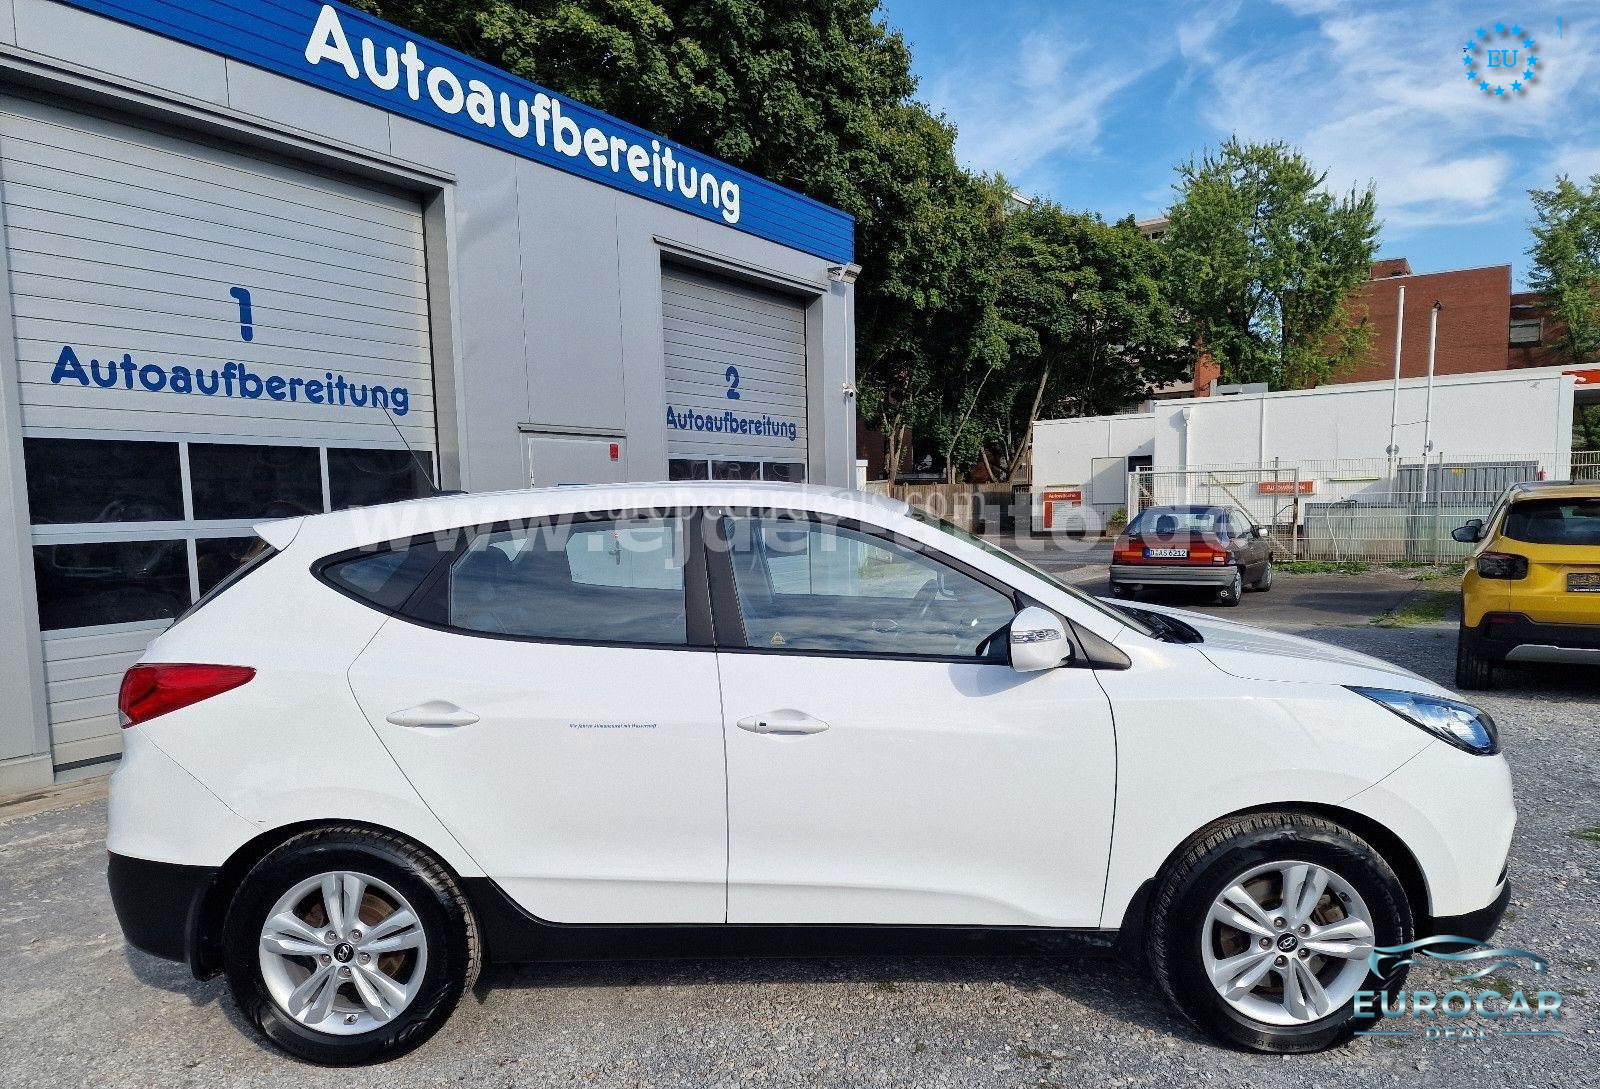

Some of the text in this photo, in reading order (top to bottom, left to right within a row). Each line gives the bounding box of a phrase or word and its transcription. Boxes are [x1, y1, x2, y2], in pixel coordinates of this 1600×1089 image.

[305, 4, 740, 224] Autoaufbereitung
[229, 287, 253, 342] 1
[51, 345, 409, 415] Autoaufbereitung
[725, 365, 740, 400] 2
[667, 405, 797, 441] Autoaufbereitung
